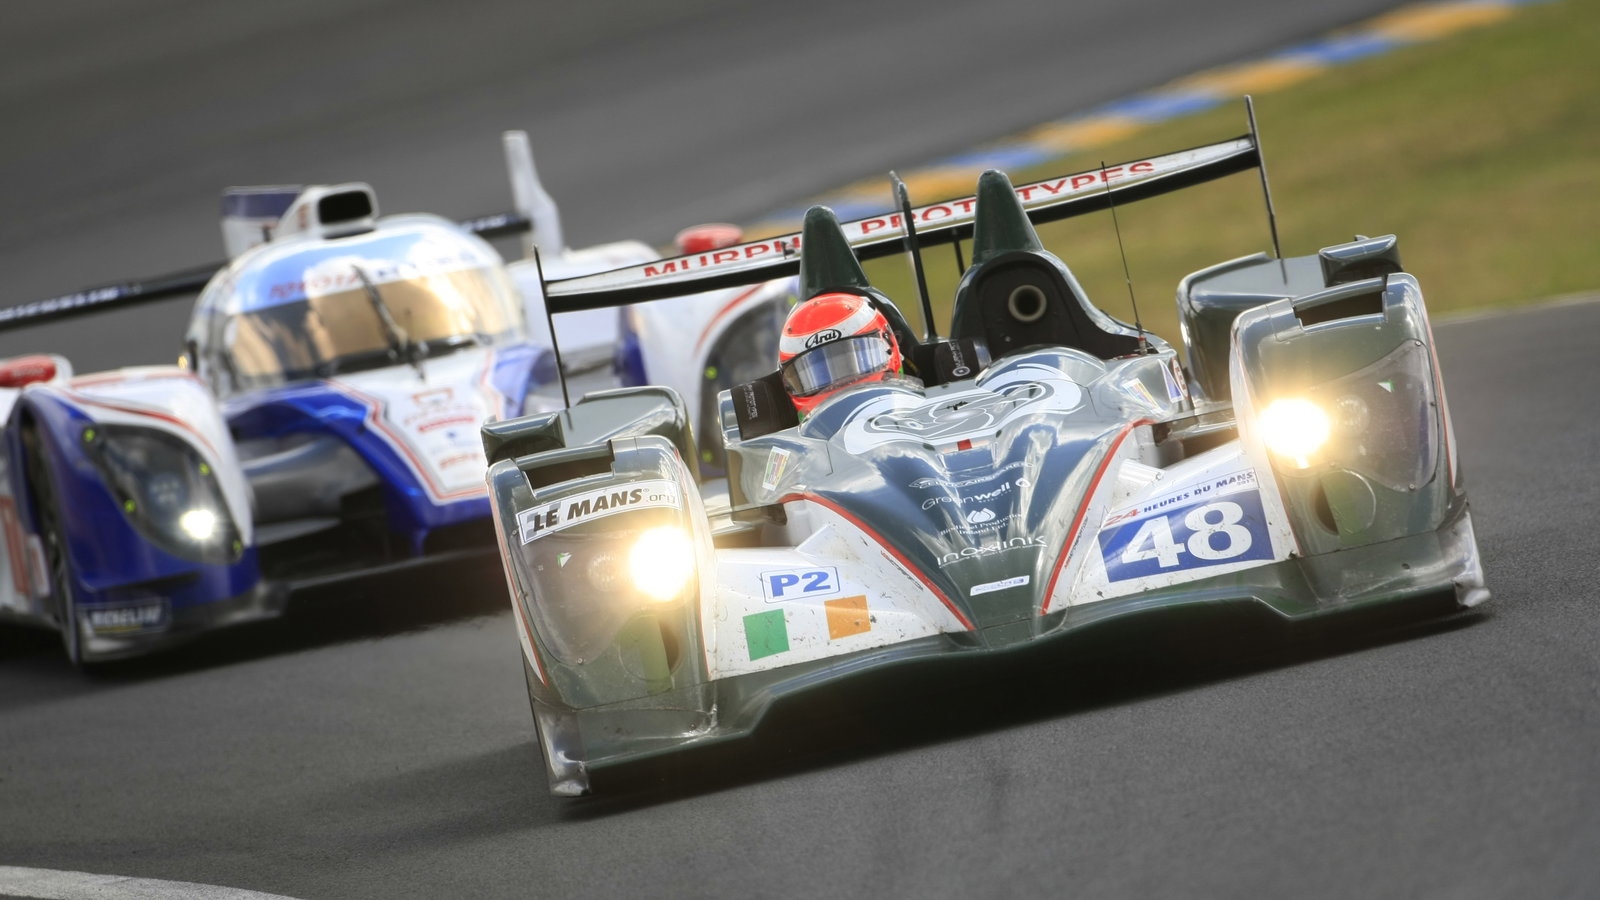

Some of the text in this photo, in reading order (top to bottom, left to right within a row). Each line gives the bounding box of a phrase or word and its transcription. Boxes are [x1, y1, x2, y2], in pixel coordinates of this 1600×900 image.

[643, 161, 1155, 278] MURPH PROTTYPES
[808, 330, 838, 348] Arai
[533, 508, 560, 532] LE
[566, 487, 643, 521] MANS
[1104, 471, 1254, 526] 24 HEURES DU MANS
[1121, 501, 1253, 569] 48
[769, 570, 832, 598] P2
